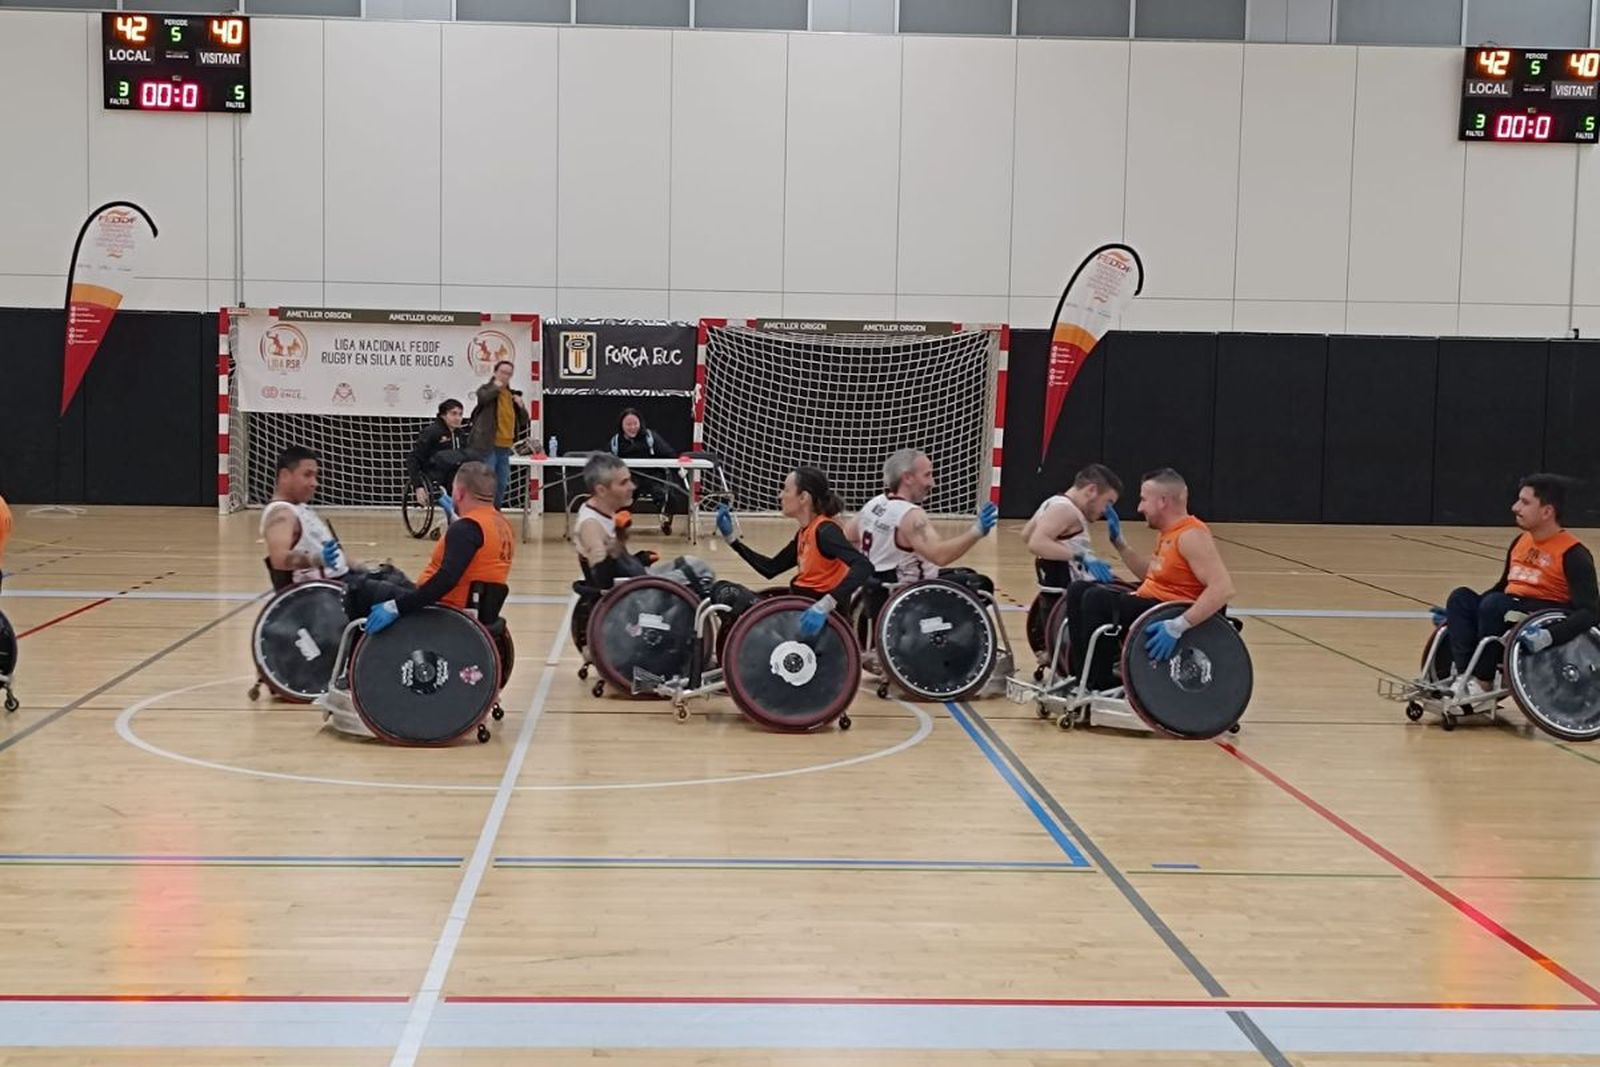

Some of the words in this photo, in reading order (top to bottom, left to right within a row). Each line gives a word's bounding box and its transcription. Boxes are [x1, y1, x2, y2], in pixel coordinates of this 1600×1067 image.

[116, 16, 148, 41] 42
[171, 27, 182, 42] 5
[212, 20, 243, 44] 40
[109, 49, 151, 62] LOCAL
[200, 52, 241, 65] VISITANT
[1480, 51, 1510, 75] 42
[1531, 60, 1541, 75] 5
[1570, 53, 1600, 77] 40
[119, 81, 129, 97] 3
[142, 83, 198, 108] 00:0
[234, 85, 245, 100] 5
[1469, 83, 1508, 95] LOCAL
[1554, 84, 1594, 97] VISITANT
[1476, 114, 1486, 129] 3
[1497, 115, 1551, 138] 00:0
[1585, 116, 1595, 131] 5
[334, 338, 356, 351] LIGA
[359, 339, 407, 352] NACIONAL
[321, 352, 352, 364] RUGBY
[355, 352, 368, 365] EN
[370, 354, 397, 366] SILLA
[400, 354, 412, 366] DE
[415, 354, 454, 367] RUEDAS
[605, 344, 650, 368] FORÇA
